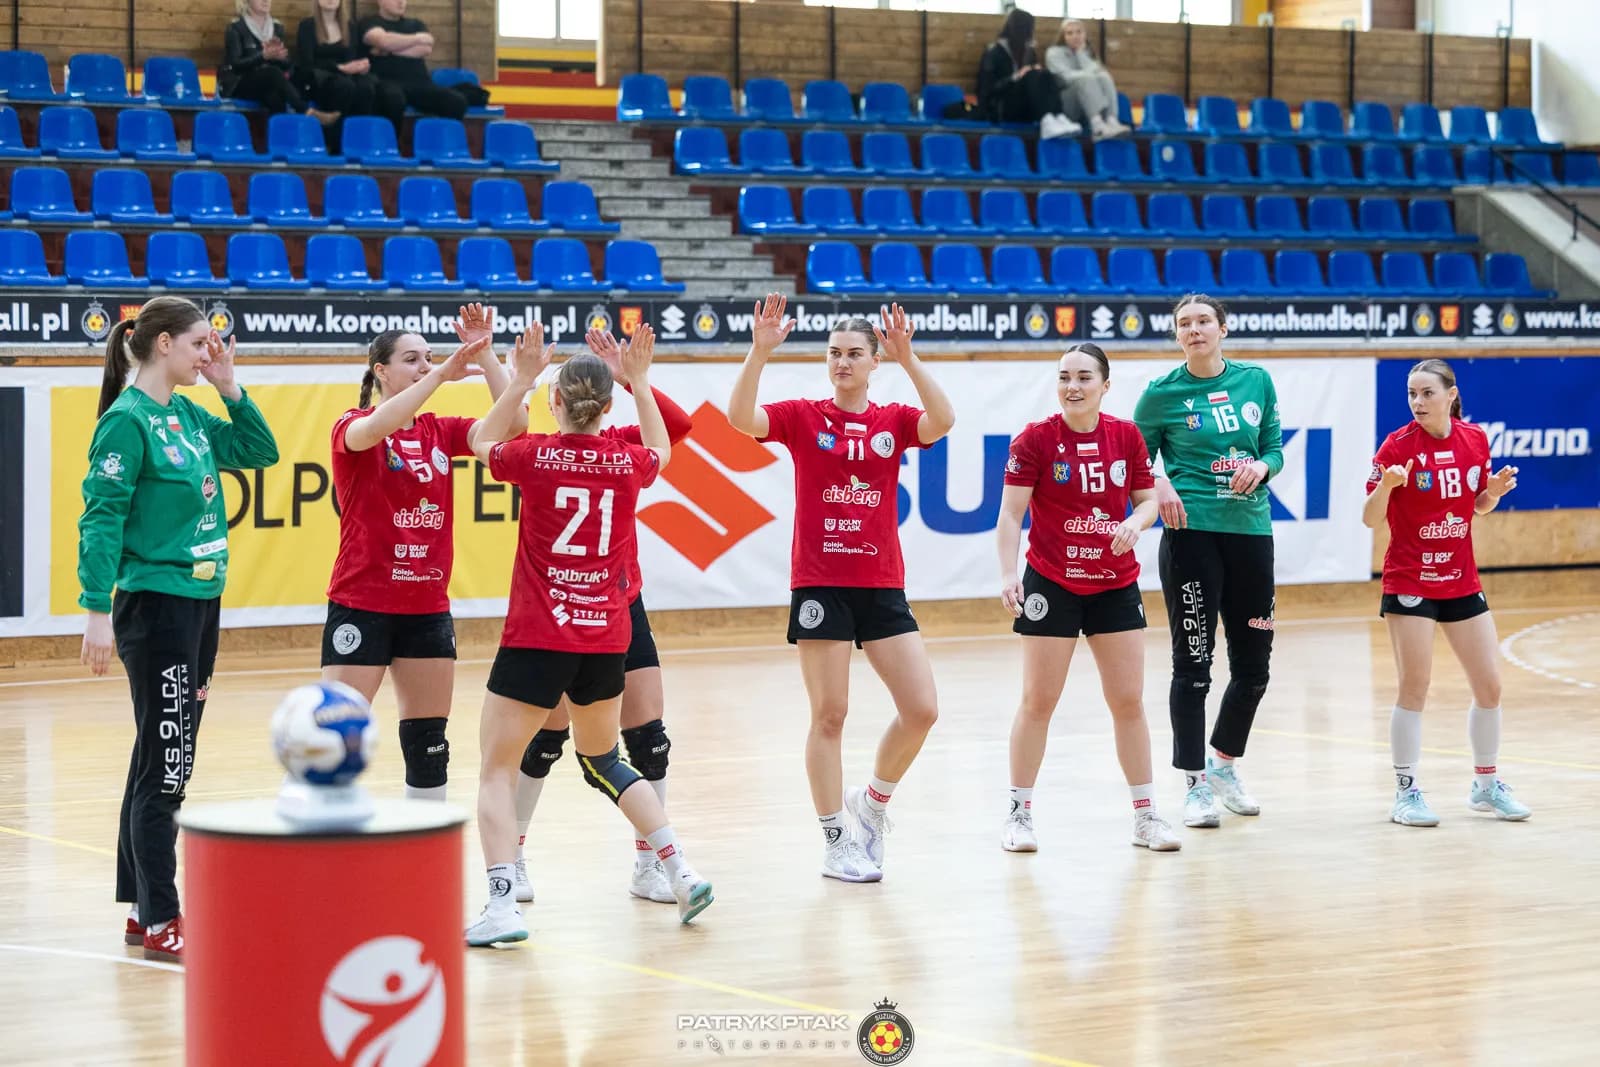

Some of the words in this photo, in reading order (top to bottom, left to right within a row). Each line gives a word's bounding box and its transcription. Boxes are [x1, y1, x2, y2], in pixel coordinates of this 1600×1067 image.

[1211, 404, 1240, 434] 16
[536, 446, 577, 463] UKS
[583, 449, 598, 464] 9
[602, 452, 633, 465] LCA
[847, 439, 865, 461] 11
[407, 459, 433, 483] 5
[534, 462, 601, 474] HANDBALL
[608, 467, 634, 475] TEAM
[1078, 461, 1105, 494] 15
[1437, 468, 1462, 499] 18
[822, 484, 882, 507] eisberg
[393, 507, 445, 529] eisberg
[551, 486, 615, 557] 21
[1419, 521, 1469, 539] eisberg
[547, 566, 602, 583] Polbruk
[1181, 581, 1196, 614] LCA
[573, 609, 607, 619] STEAM
[1183, 618, 1198, 631] 9
[161, 665, 179, 713] LCA
[181, 664, 189, 705] TEAM
[159, 720, 180, 740] 9
[160, 747, 181, 794] UKS
